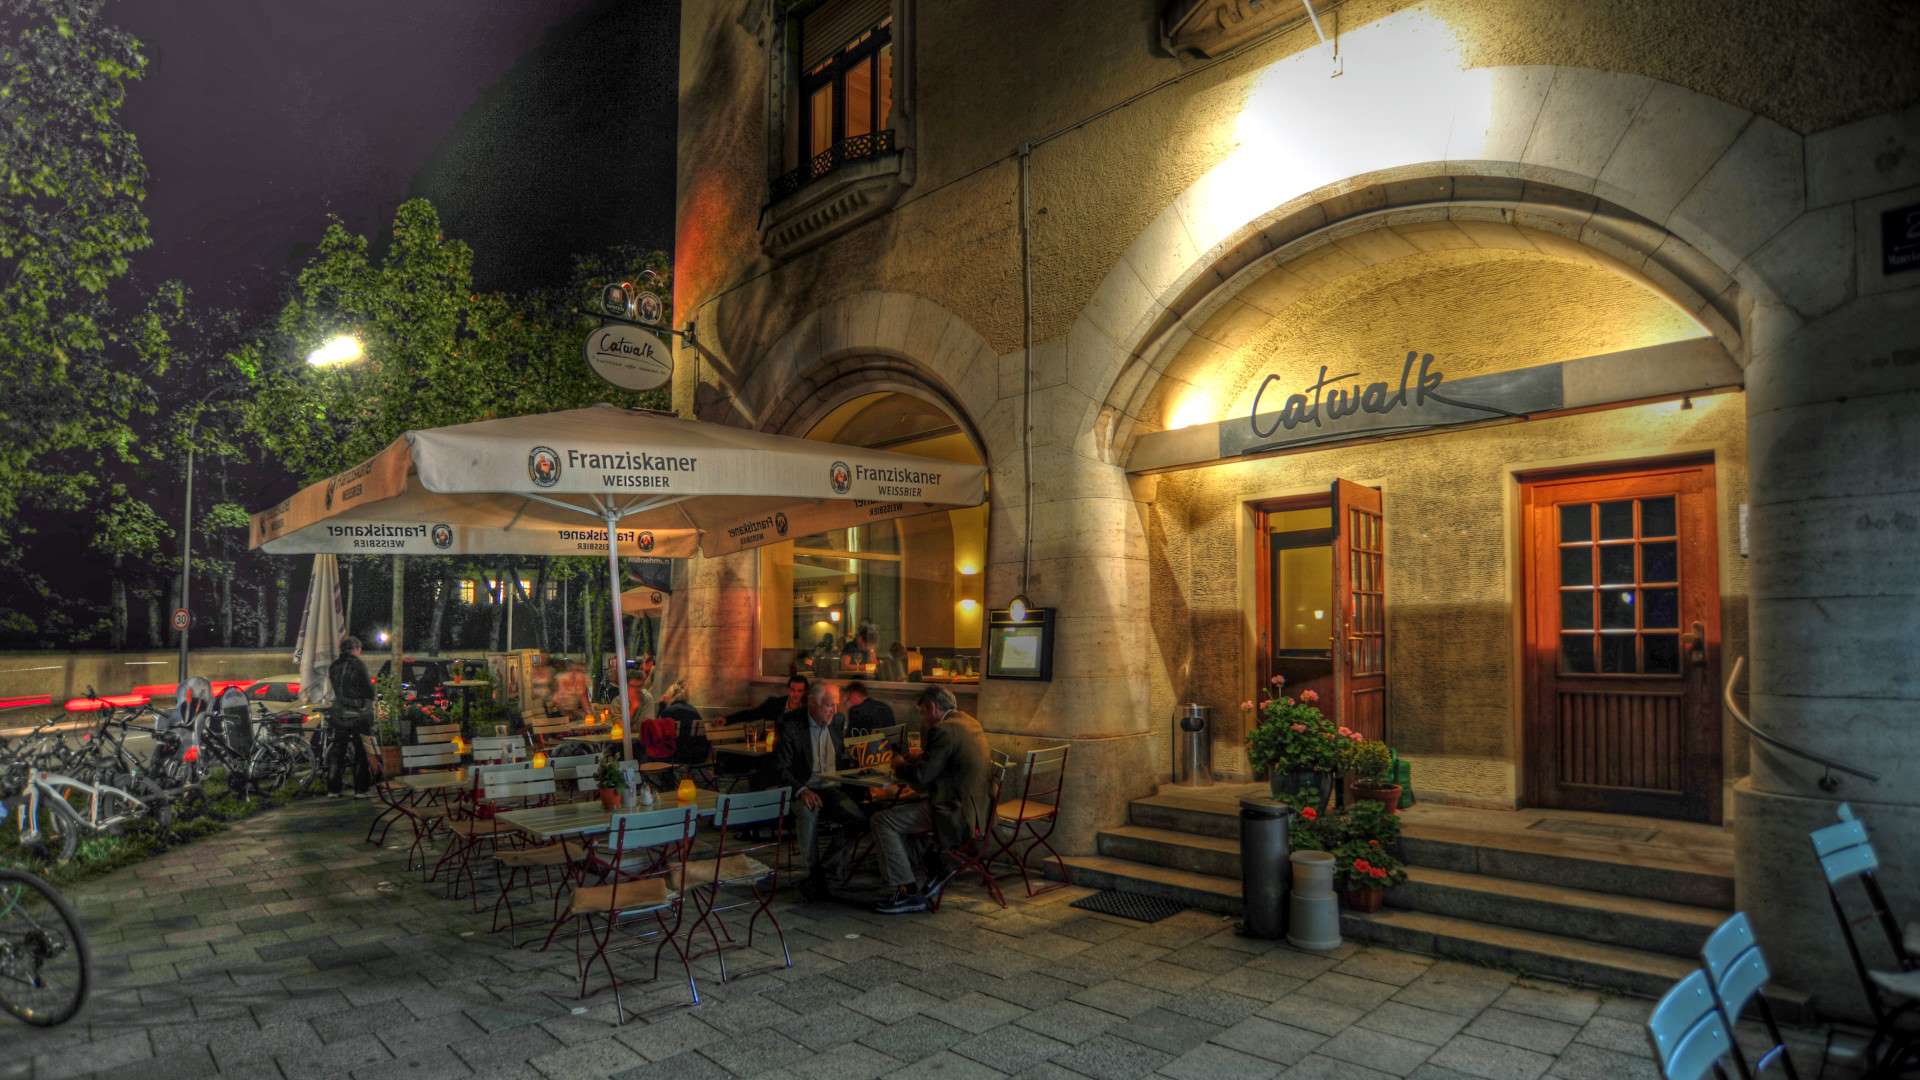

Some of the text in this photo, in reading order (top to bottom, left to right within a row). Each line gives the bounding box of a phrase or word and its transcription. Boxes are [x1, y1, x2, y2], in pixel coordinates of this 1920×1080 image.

[600, 333, 671, 362] Catwalk
[1244, 351, 1529, 440] Catwalk
[567, 449, 698, 472] Franziskaner
[602, 474, 671, 488] WEISSBIER
[855, 464, 942, 486] Franziskaner
[878, 485, 922, 498] WEISSBIER
[176, 615, 187, 625] 30
